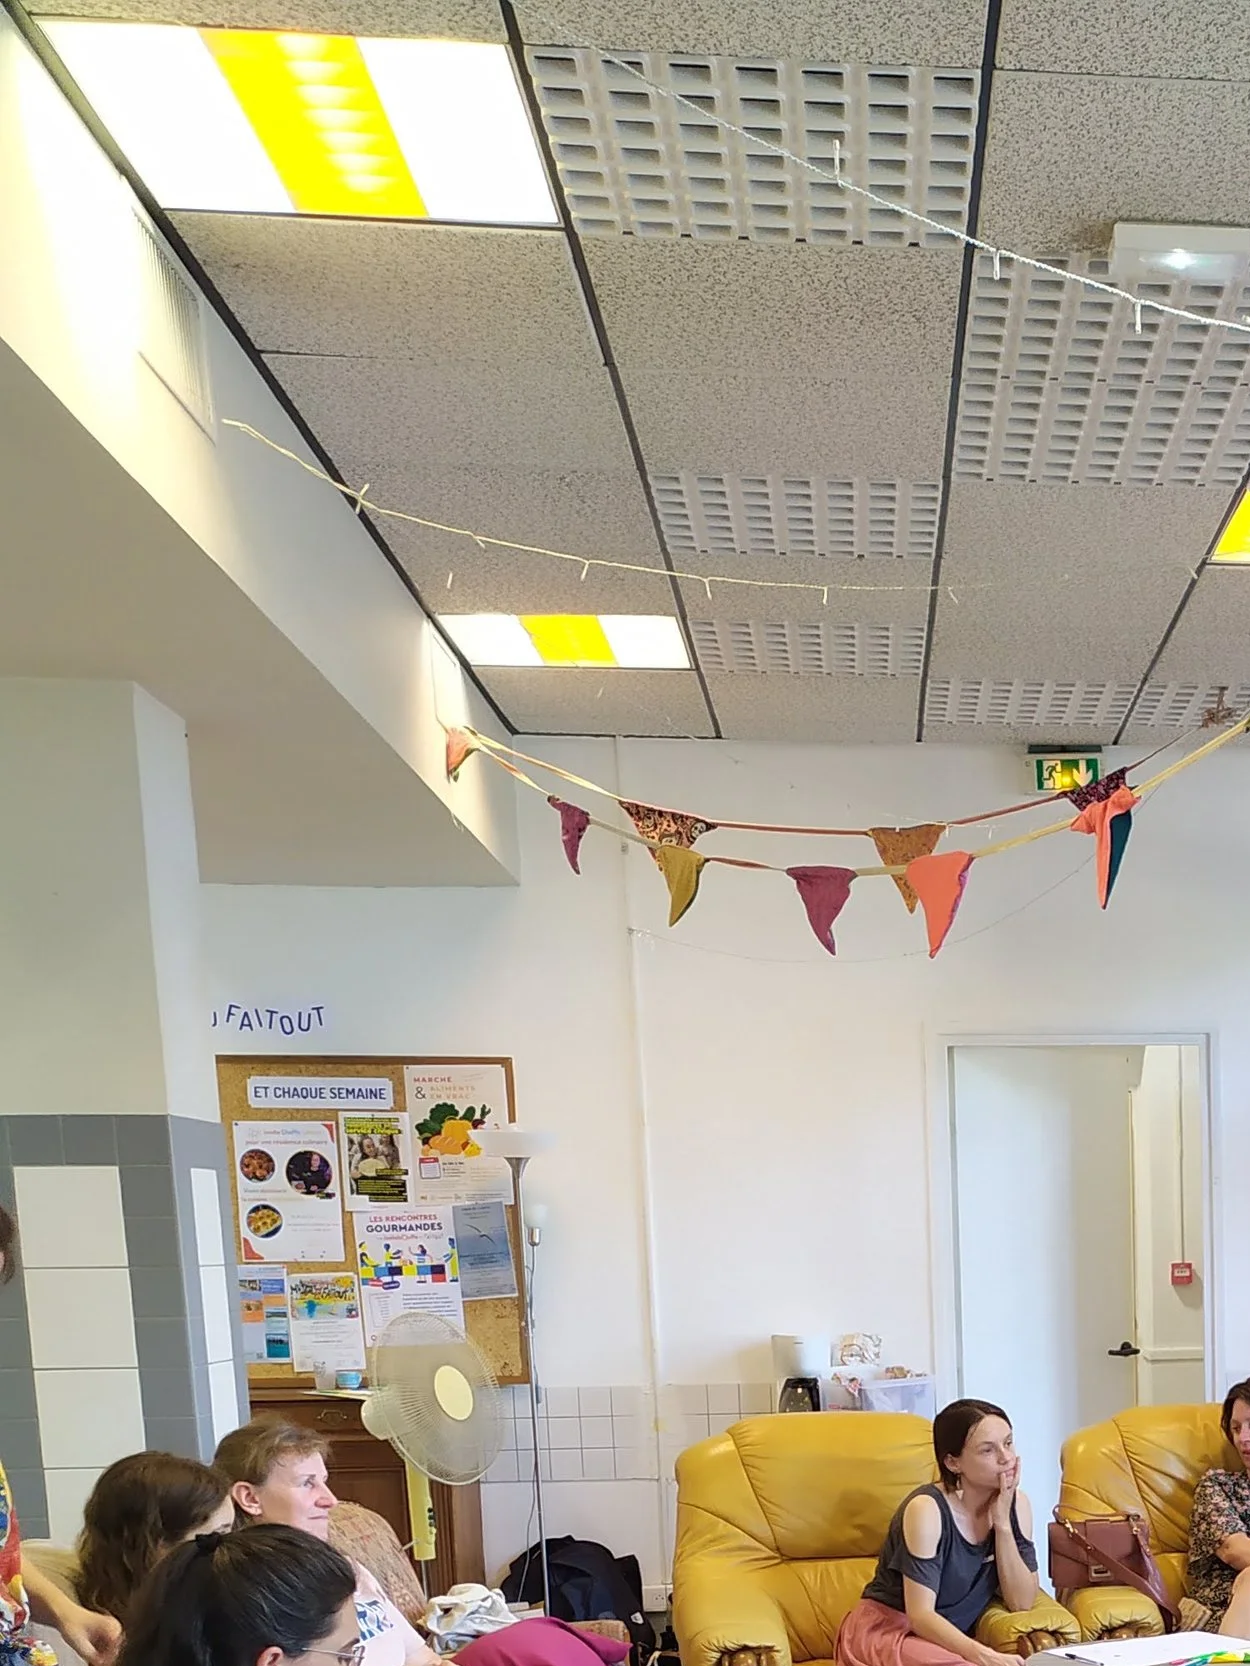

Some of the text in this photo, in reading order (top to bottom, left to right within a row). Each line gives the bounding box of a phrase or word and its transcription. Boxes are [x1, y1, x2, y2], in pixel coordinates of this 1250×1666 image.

[226, 1004, 324, 1035] FAITOUT
[253, 1086, 387, 1100] ET CHAQUE SEMAINE
[414, 1086, 426, 1100] &
[369, 1214, 437, 1223] LES RENCONTRES
[365, 1222, 443, 1233] GOURMANDES
